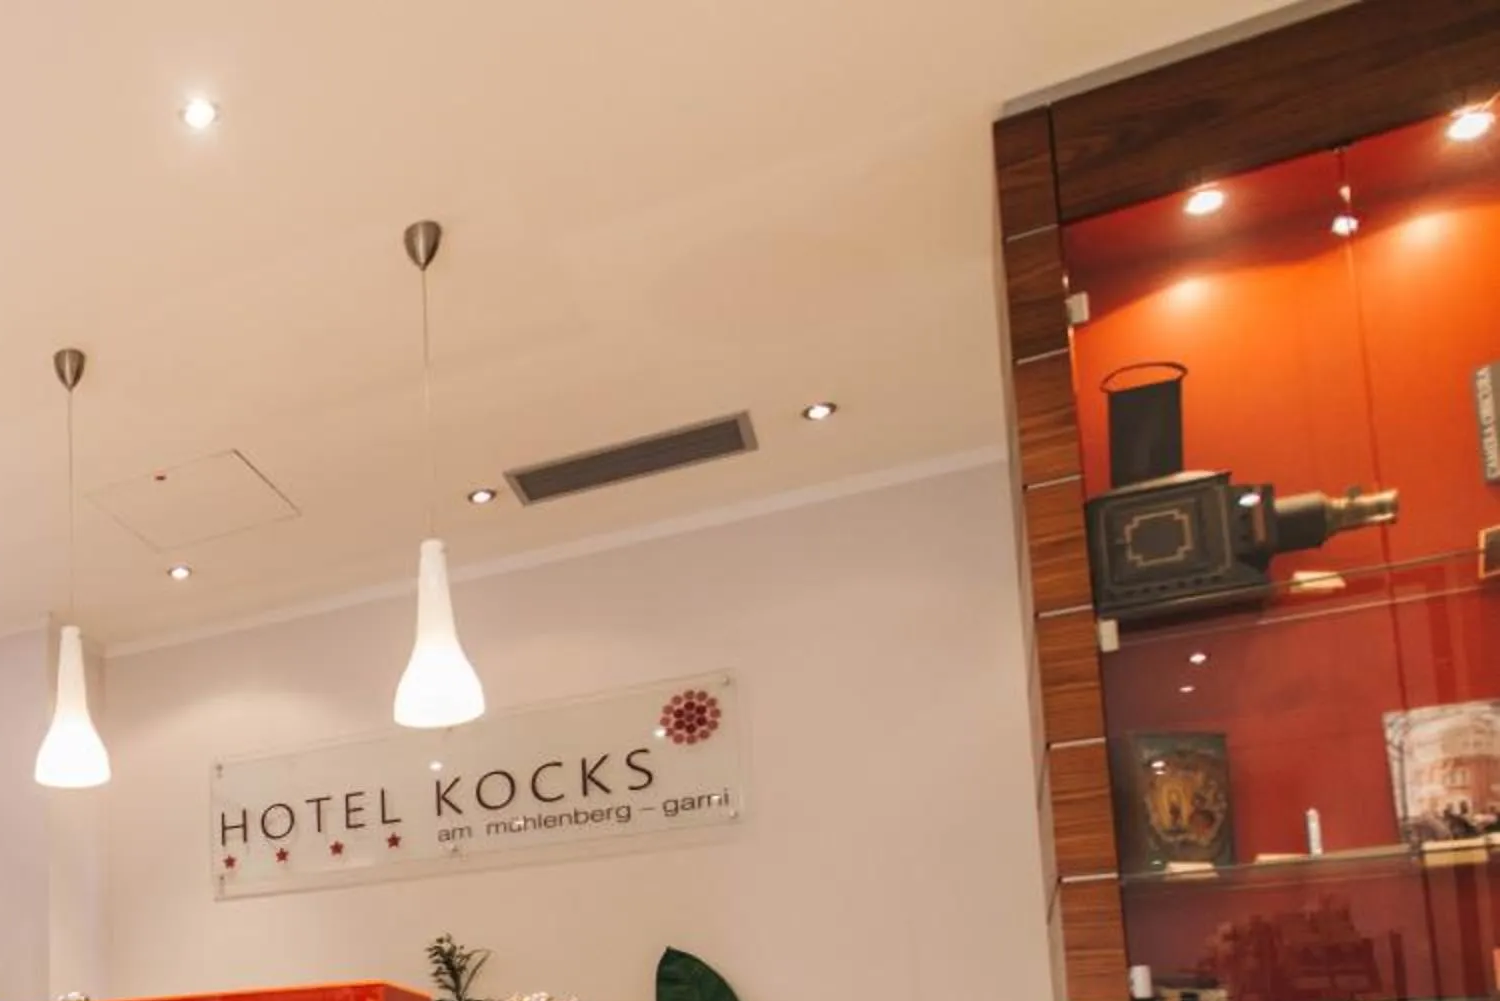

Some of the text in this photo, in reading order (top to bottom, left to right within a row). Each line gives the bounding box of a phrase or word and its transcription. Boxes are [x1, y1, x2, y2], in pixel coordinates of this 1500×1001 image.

[220, 748, 654, 846] HOTEL KOCKS
[437, 825, 472, 842] am
[485, 805, 632, 836] mühlenberg
[661, 786, 730, 818] garni
